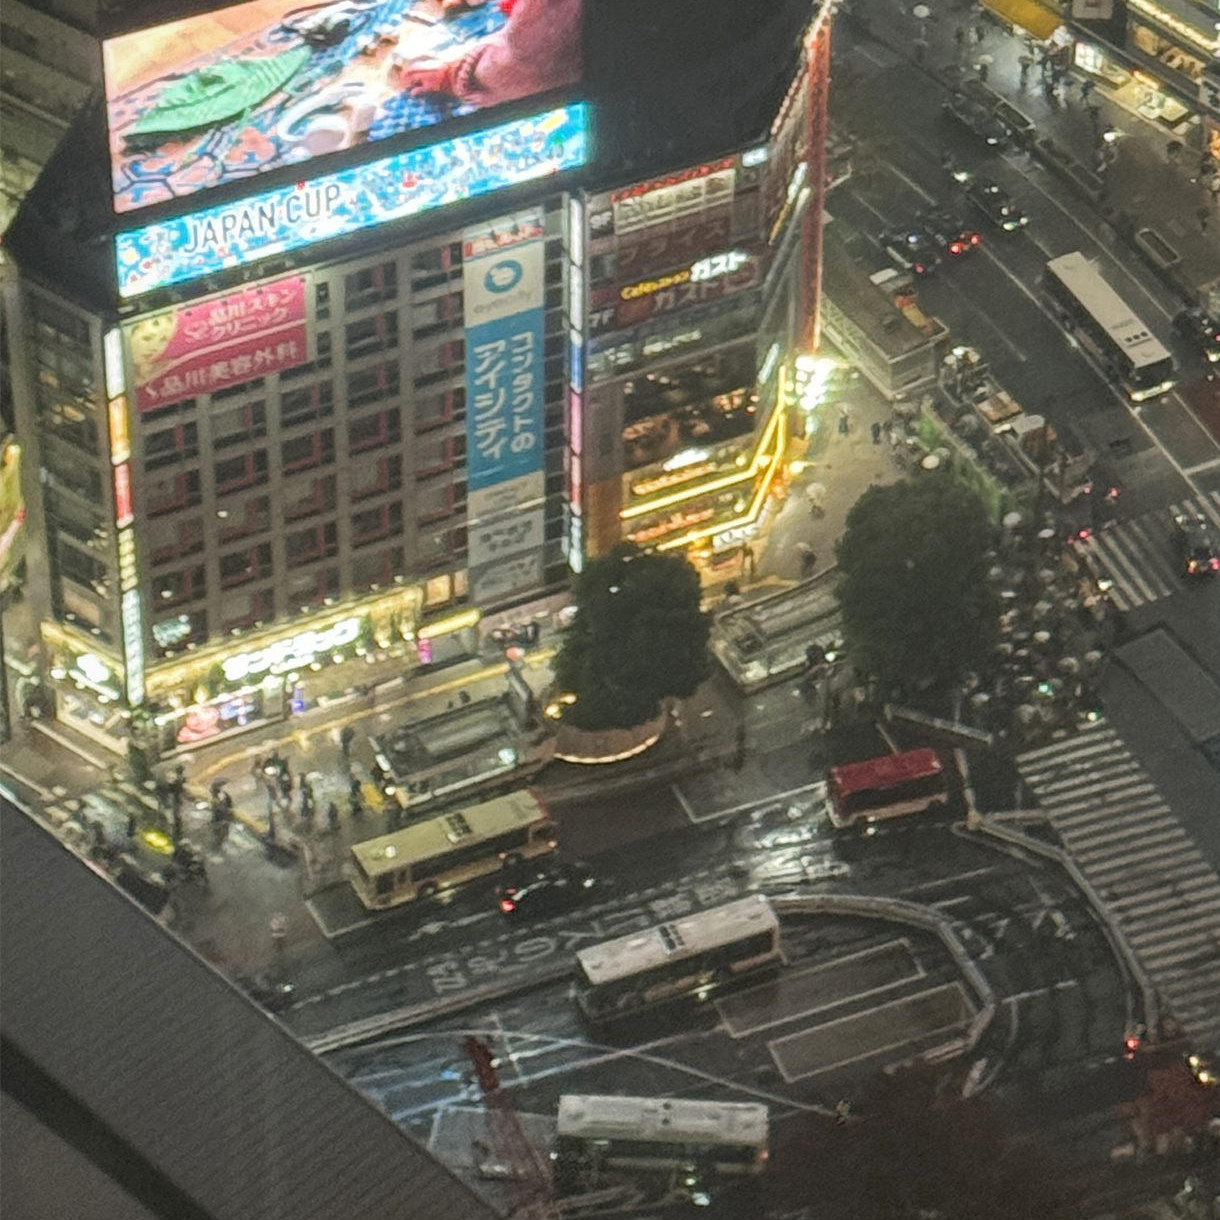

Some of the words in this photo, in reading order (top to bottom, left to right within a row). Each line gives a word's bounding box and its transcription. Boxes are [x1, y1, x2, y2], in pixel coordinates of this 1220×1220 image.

[182, 203, 277, 254] JAPAN
[285, 184, 342, 224] CUP
[690, 249, 748, 282] ガスト
[213, 307, 289, 342] クリニック
[473, 339, 507, 459] アイシティ
[510, 331, 535, 453] コンタクトの
